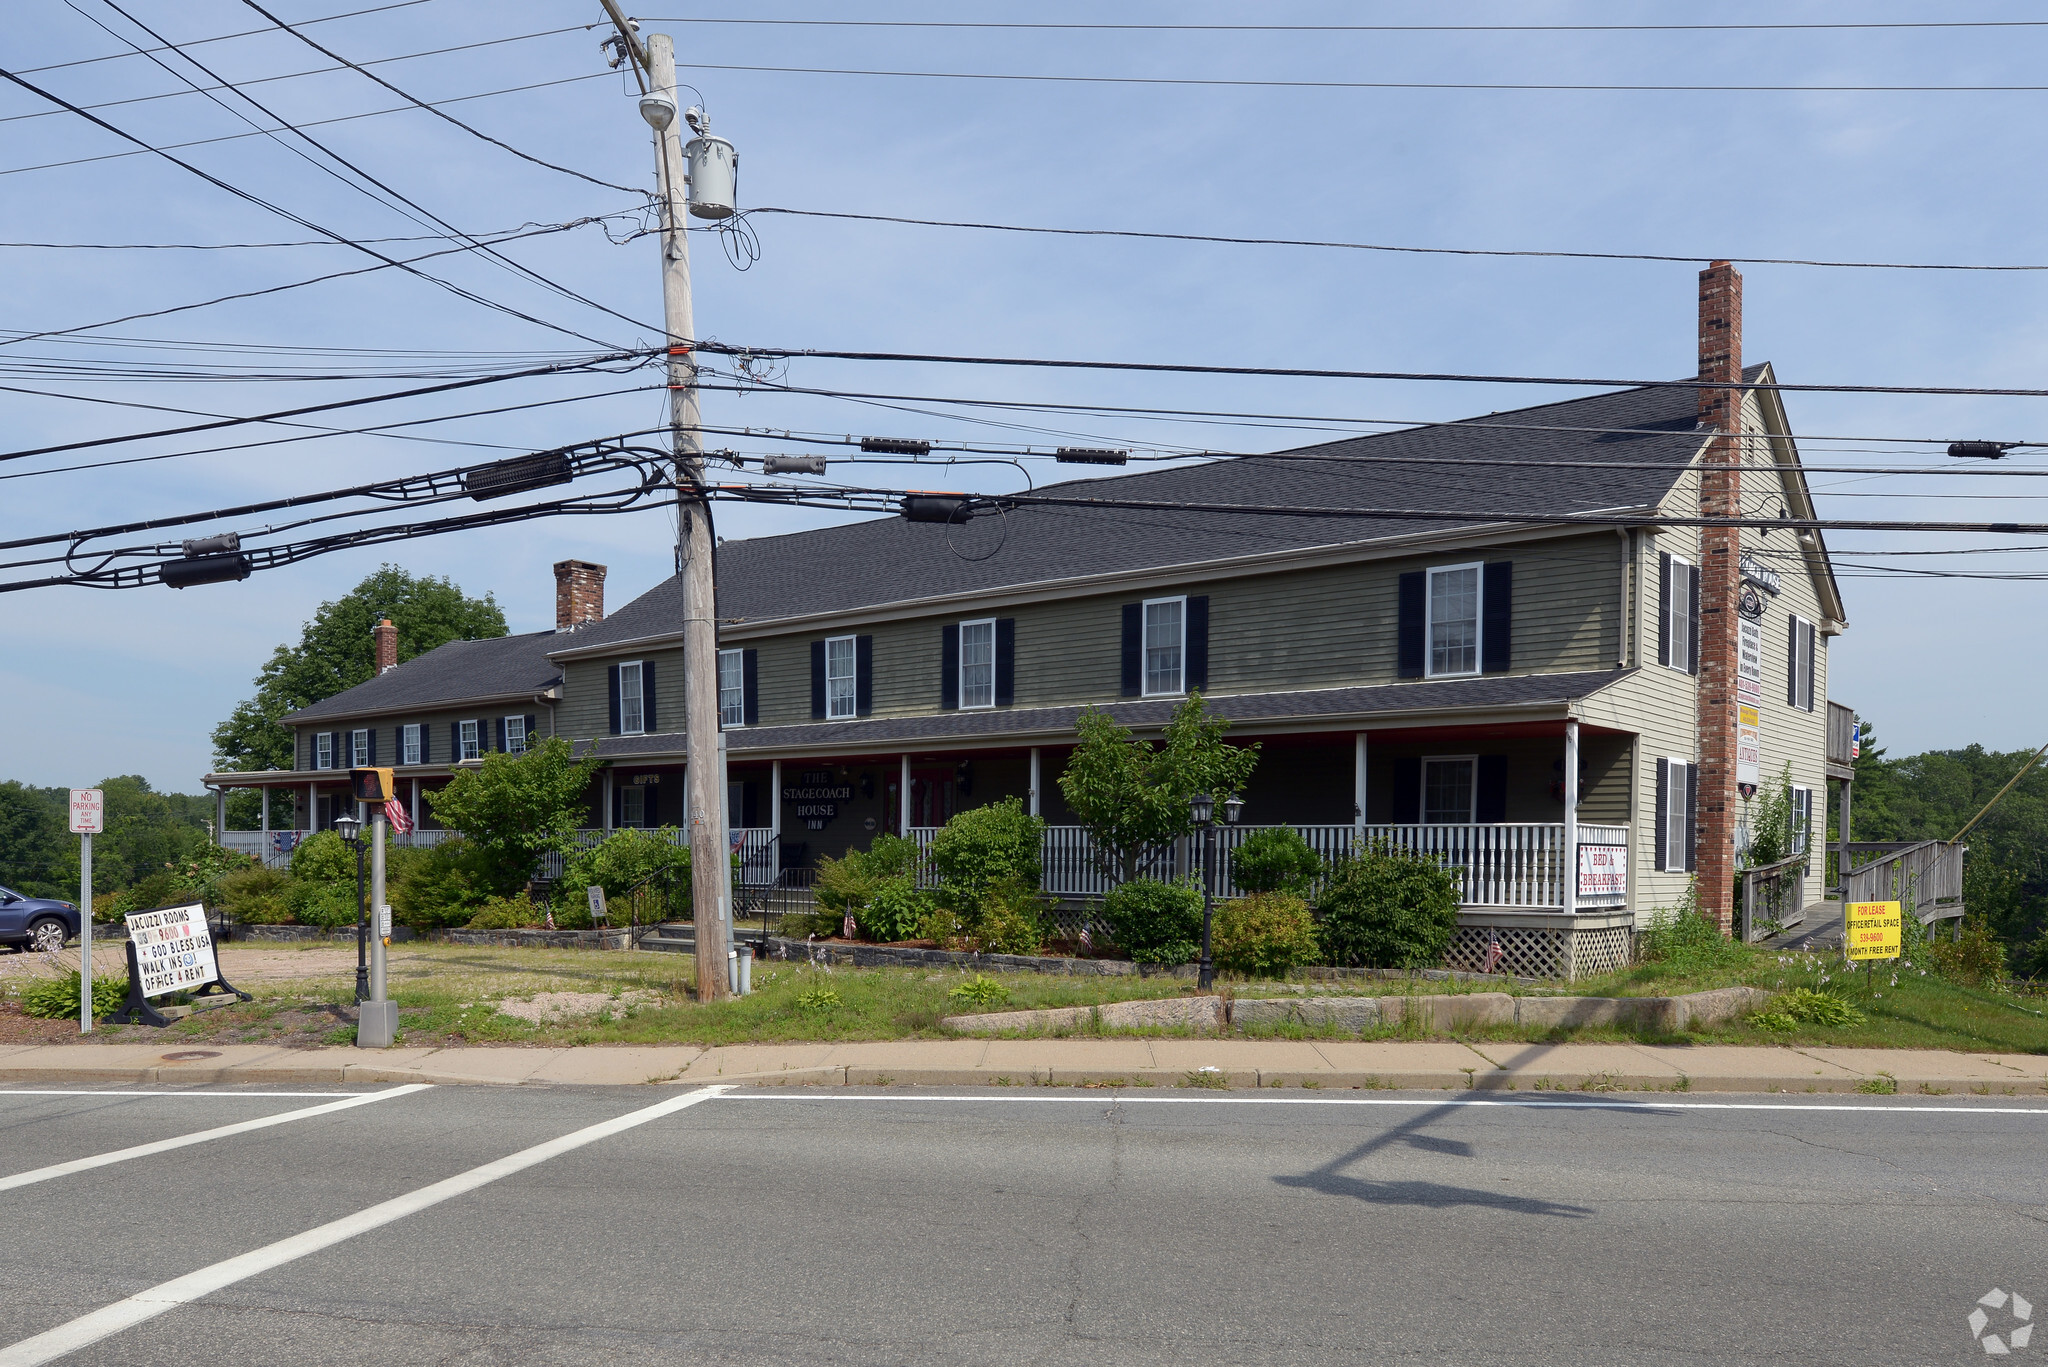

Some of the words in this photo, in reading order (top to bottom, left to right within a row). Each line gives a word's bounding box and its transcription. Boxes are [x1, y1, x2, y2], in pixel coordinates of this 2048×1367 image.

[1739, 746, 1758, 763] ANTIQUES
[633, 774, 660, 785] GIFTS
[804, 772, 828, 783] THE
[81, 793, 92, 801] NO
[783, 787, 850, 799] STAGECOACH
[73, 802, 99, 811] PARKING
[797, 805, 834, 816] HOUSE
[807, 820, 823, 830] INN
[1593, 853, 1607, 866] BED
[1610, 854, 1614, 866] &
[1583, 873, 1622, 886] BREAKFAST
[1857, 905, 1868, 916] FOR
[1869, 905, 1886, 915] LEASE
[131, 913, 163, 931] JACUZZI
[163, 909, 190, 925] ROOMS
[1883, 918, 1900, 928] SPACE
[158, 926, 179, 941] 9600
[1860, 932, 1884, 943] 539-9600
[152, 944, 167, 958] GOD
[170, 938, 195, 954] BLESS
[196, 936, 210, 949] USA
[1850, 947, 1868, 956] MONTH
[1869, 946, 1884, 954] FREE
[1885, 945, 1899, 954] RENT
[142, 959, 166, 976] WALK
[145, 973, 175, 991] OFFICE
[178, 971, 183, 983] 4
[185, 966, 205, 981] RENT
